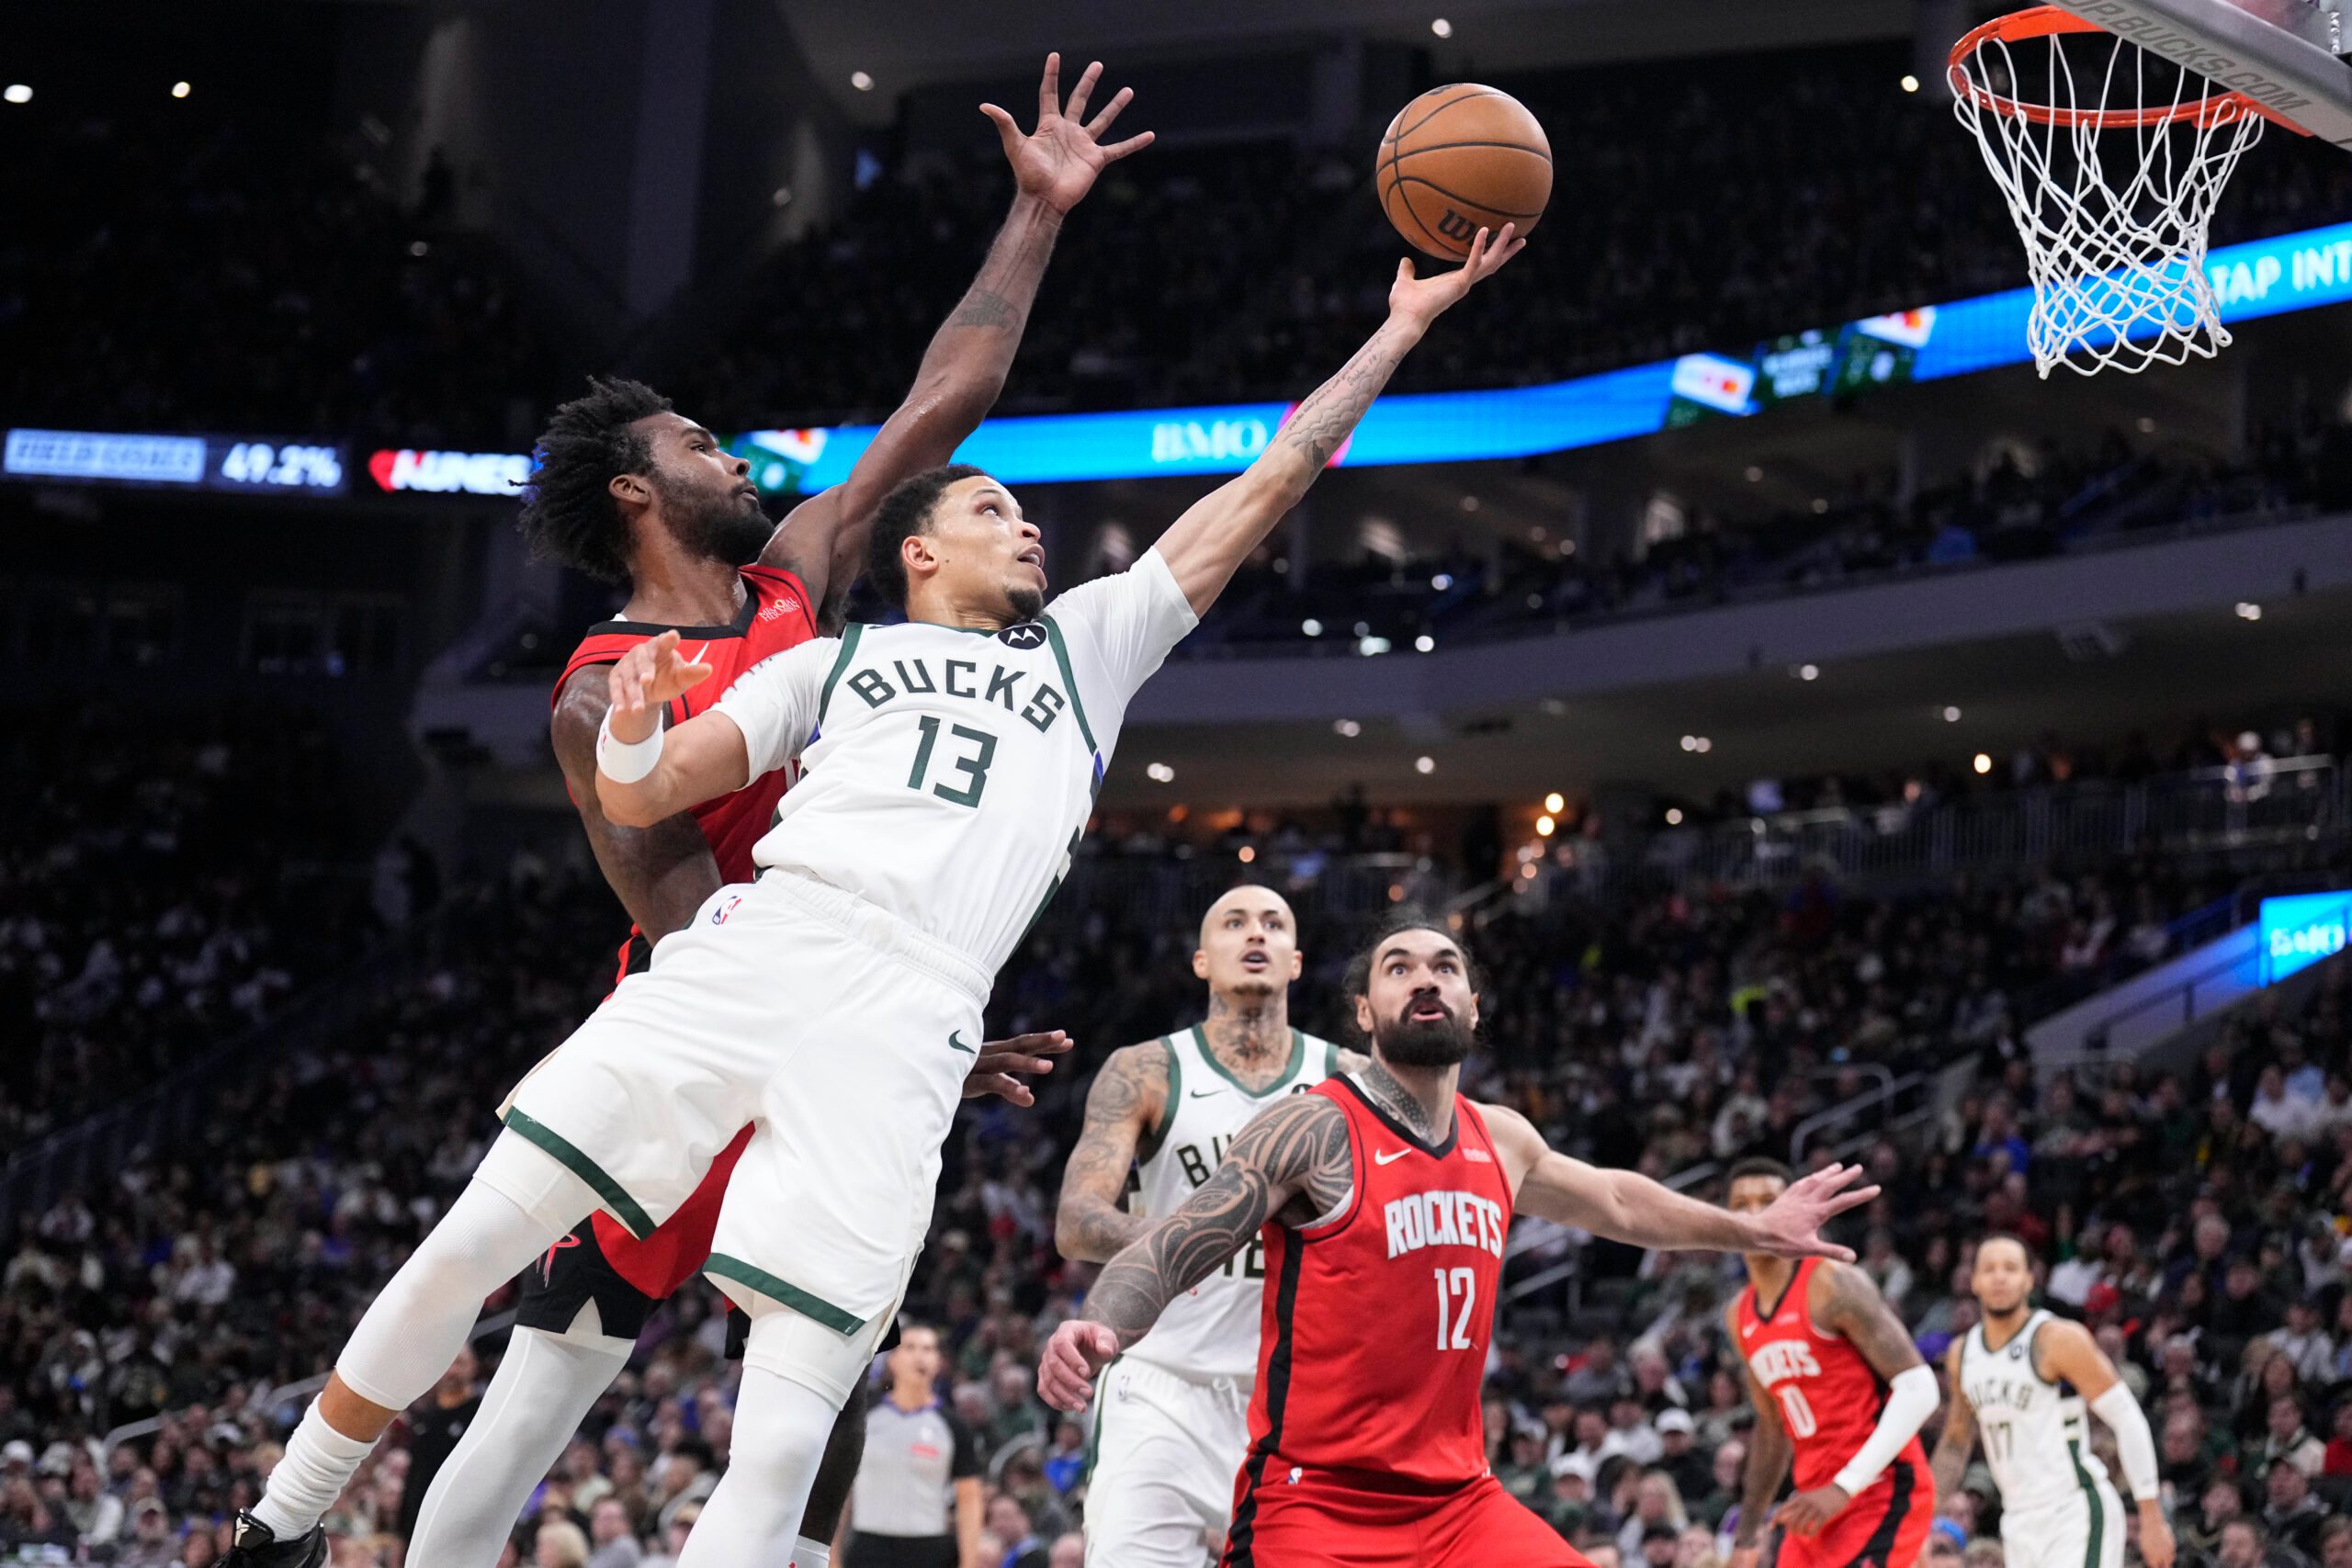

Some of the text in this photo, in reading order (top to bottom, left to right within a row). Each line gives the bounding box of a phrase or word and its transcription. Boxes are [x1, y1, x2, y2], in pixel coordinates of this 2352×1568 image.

[2210, 240, 2352, 307] TAP INT
[220, 442, 342, 488] 49.2%
[1151, 420, 1268, 463] BMO
[846, 658, 1066, 734] BUCKS
[907, 715, 999, 808] 13
[1384, 1190, 1503, 1260] ROCKETS
[1433, 1267, 1476, 1350] 12
[1986, 1421, 2012, 1462] 17
